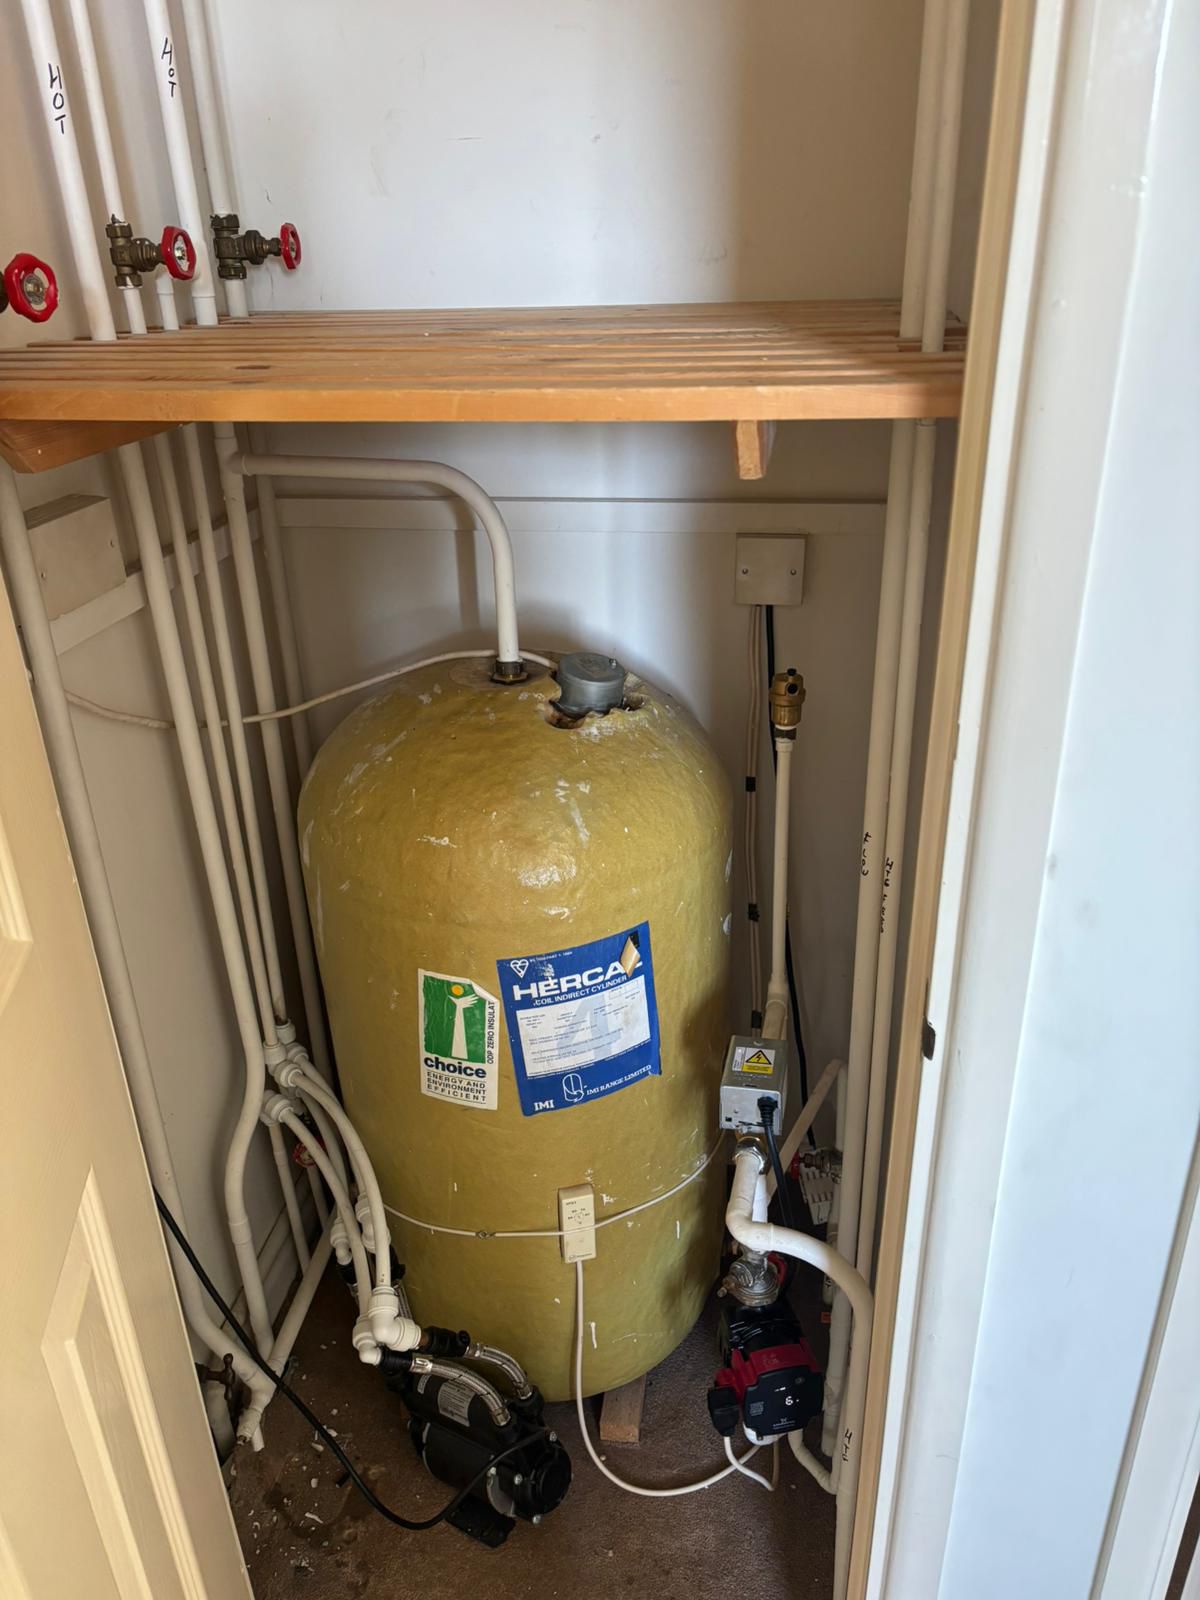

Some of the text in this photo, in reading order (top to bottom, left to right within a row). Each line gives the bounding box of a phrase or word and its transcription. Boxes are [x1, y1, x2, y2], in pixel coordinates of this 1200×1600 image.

[161, 37, 177, 98] HOT
[48, 62, 67, 135] HOT
[513, 961, 643, 1001] HERCA
[555, 989, 590, 1003] INDIRECT
[591, 975, 627, 993] CYLINDER
[487, 1031, 495, 1049] ZERO
[424, 1056, 487, 1079] choice
[600, 1078, 623, 1092] RANGE
[624, 1064, 652, 1082] LIMITED
[427, 1071, 486, 1089] ENERGY AND
[427, 1077, 487, 1095] ENVIRONMENT
[427, 1083, 487, 1102] EFFICIENT
[533, 1099, 555, 1112] IMI
